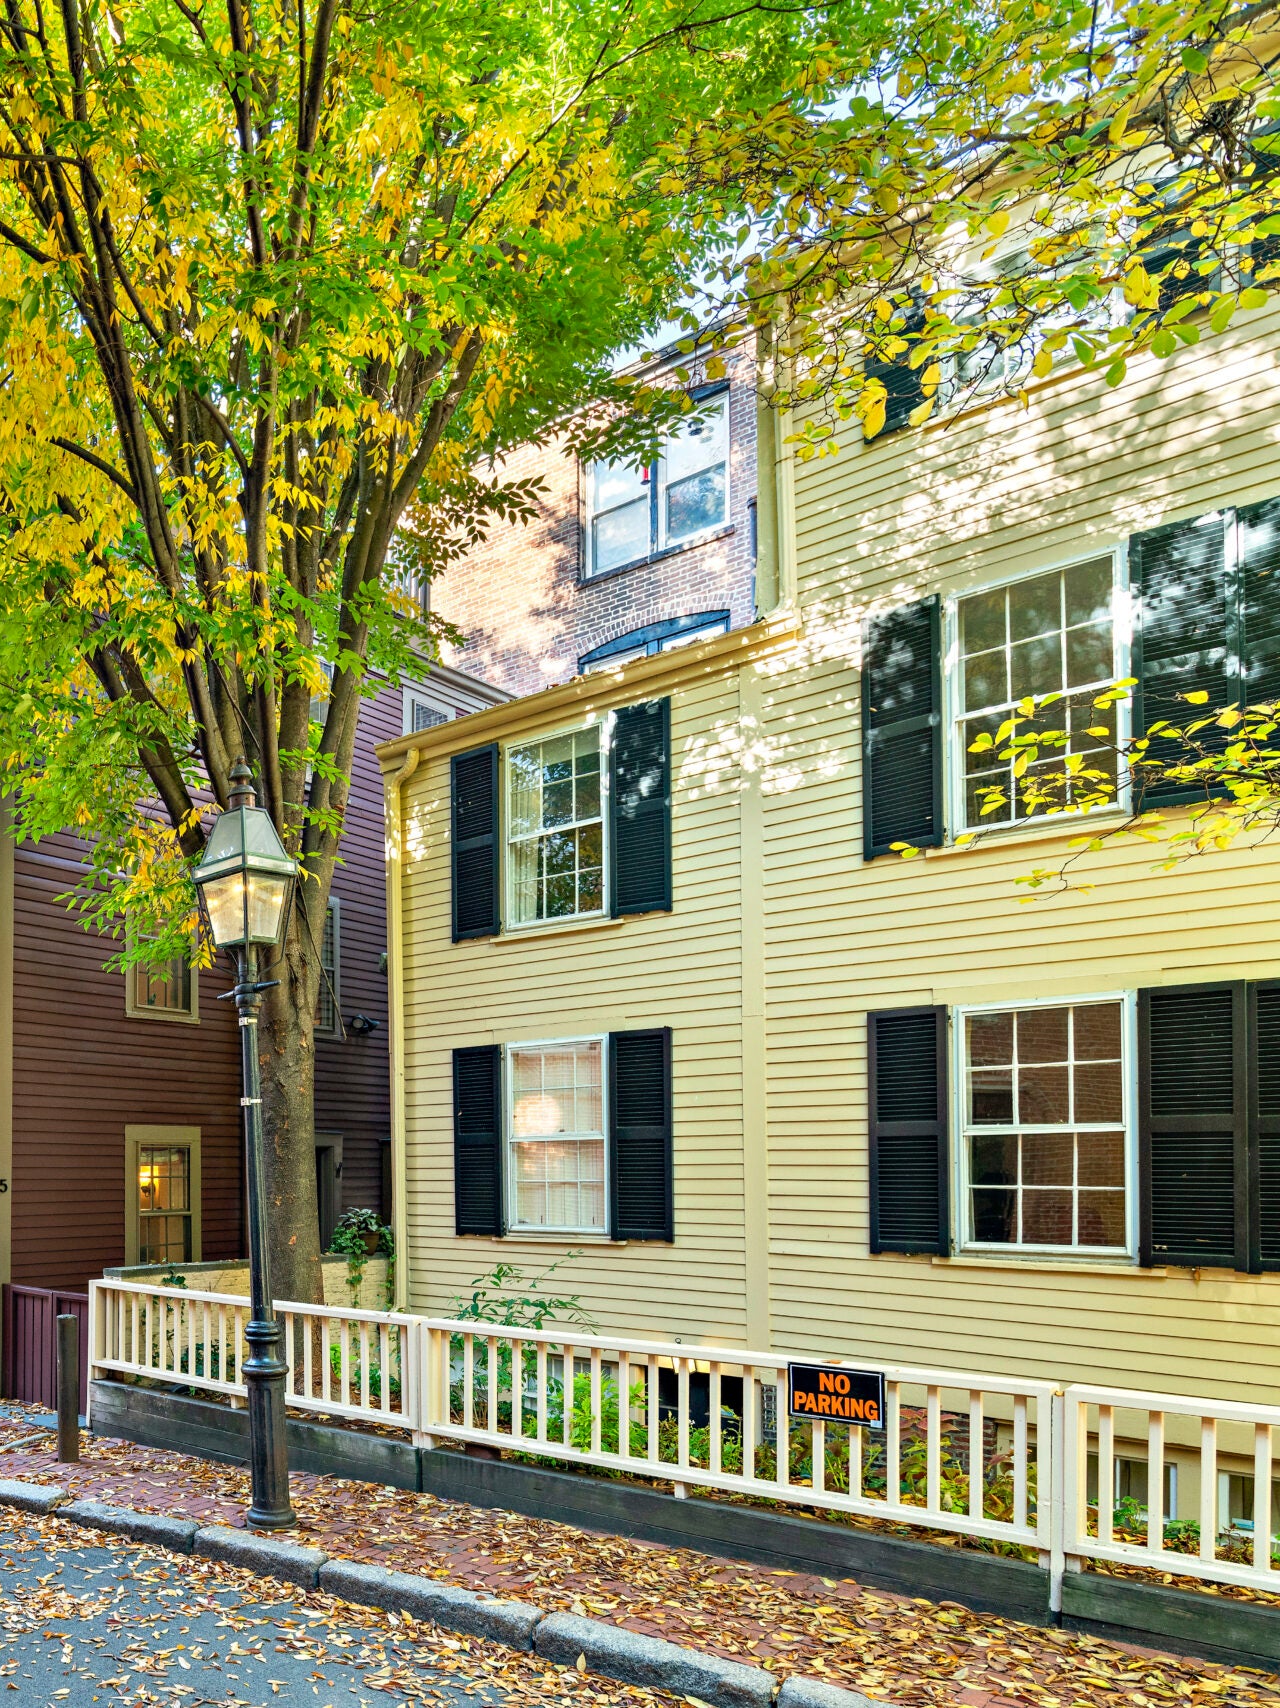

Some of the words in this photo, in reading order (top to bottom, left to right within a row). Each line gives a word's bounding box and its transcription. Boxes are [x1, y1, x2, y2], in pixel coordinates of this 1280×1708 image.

[0, 1178, 8, 1193] 5
[819, 1372, 851, 1395] NO
[793, 1391, 879, 1420] PARKING
